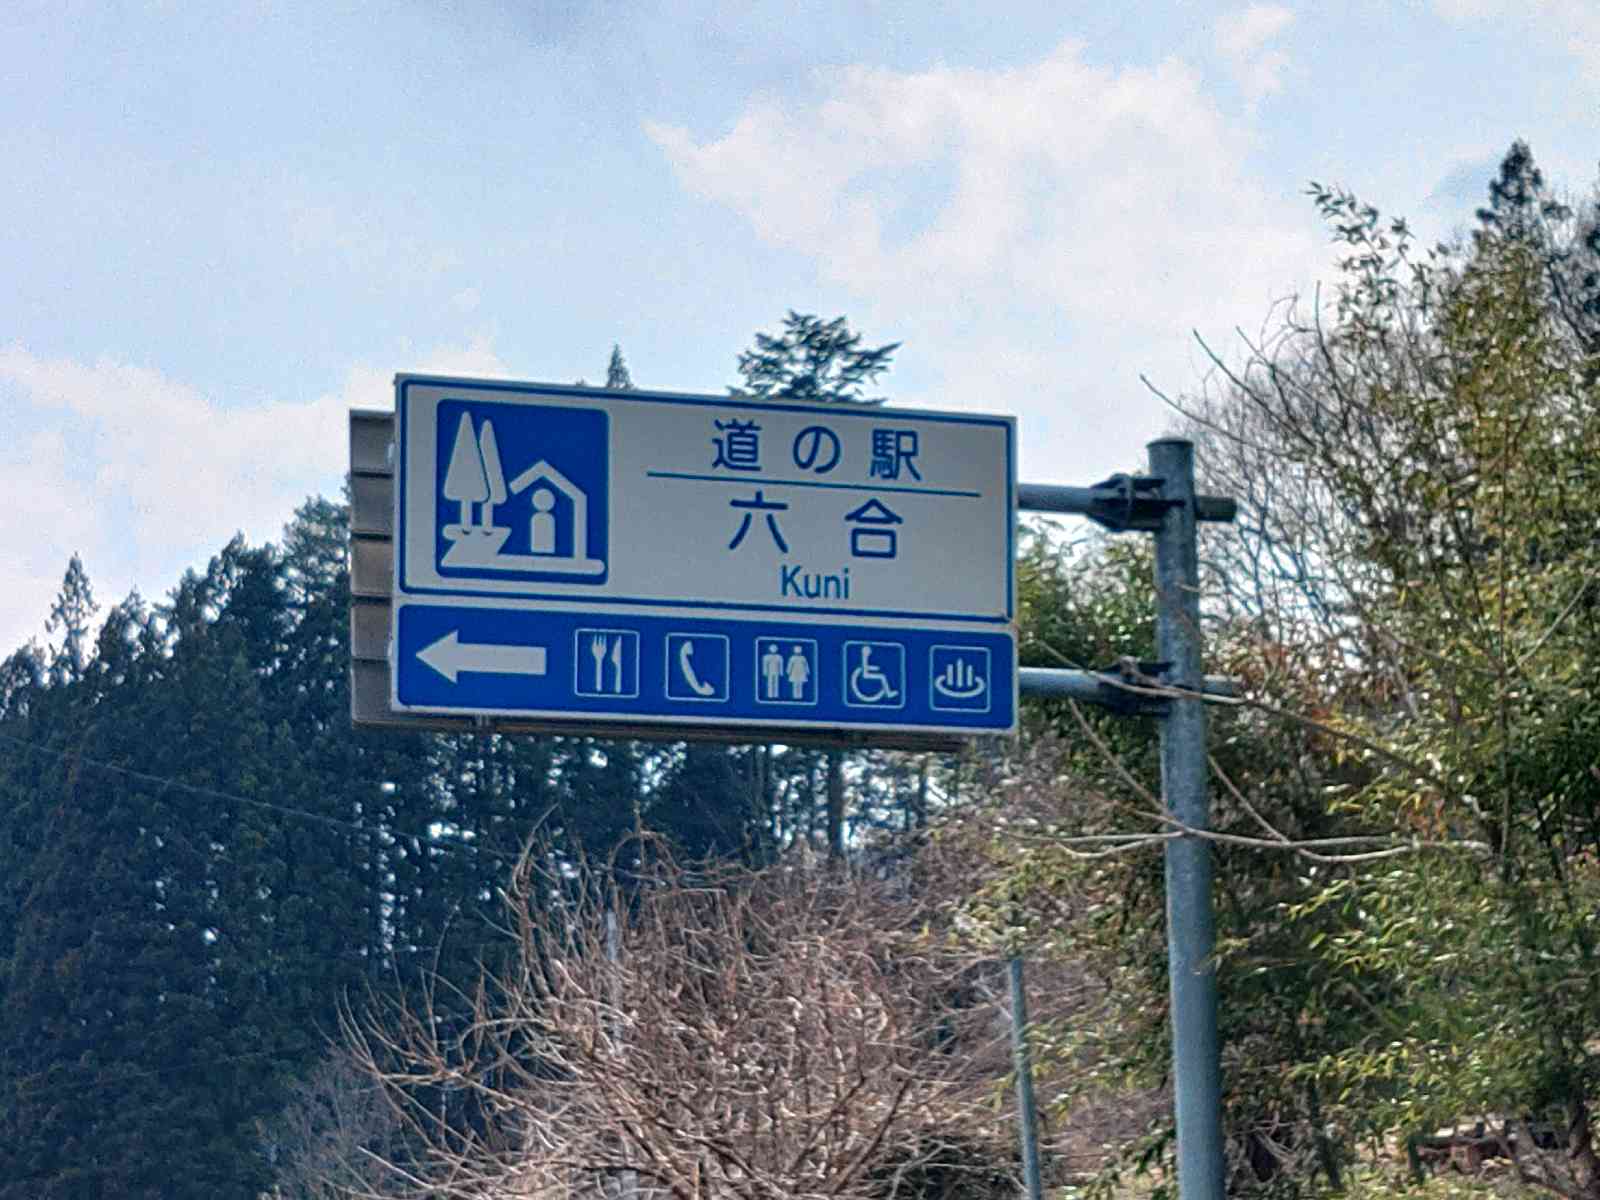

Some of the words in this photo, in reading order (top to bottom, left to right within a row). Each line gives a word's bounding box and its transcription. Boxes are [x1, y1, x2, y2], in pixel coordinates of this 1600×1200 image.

[711, 417, 922, 482] 道の駅
[728, 489, 904, 559] 六合
[779, 564, 851, 600] Kuni
